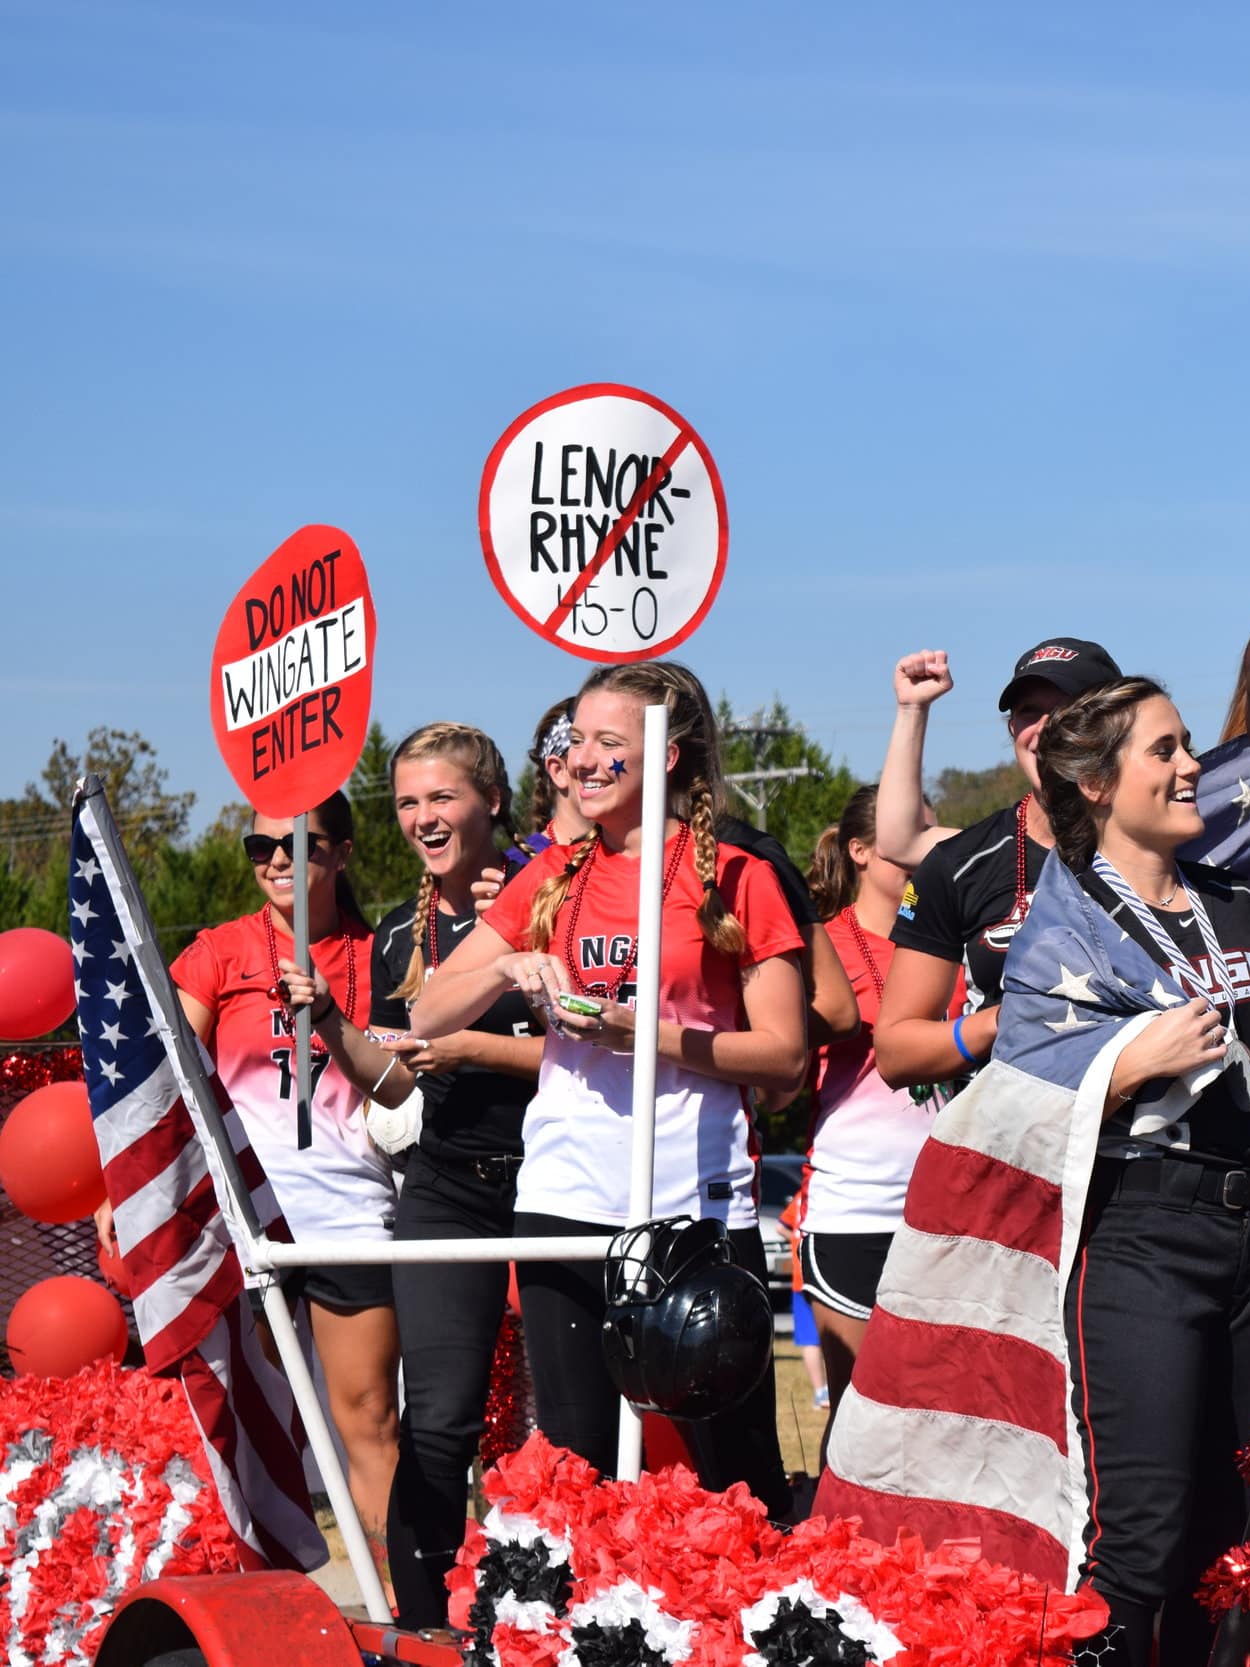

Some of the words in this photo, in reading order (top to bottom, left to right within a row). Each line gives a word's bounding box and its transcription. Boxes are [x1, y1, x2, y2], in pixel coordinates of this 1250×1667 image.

[531, 441, 691, 525] LENOIR-
[530, 511, 668, 579] RHYNE
[245, 584, 285, 651] DO
[291, 549, 342, 625] NOT
[557, 584, 658, 640] 45-0
[225, 605, 362, 724] WINGATE
[252, 686, 344, 781] ENTER
[579, 935, 638, 970] NG
